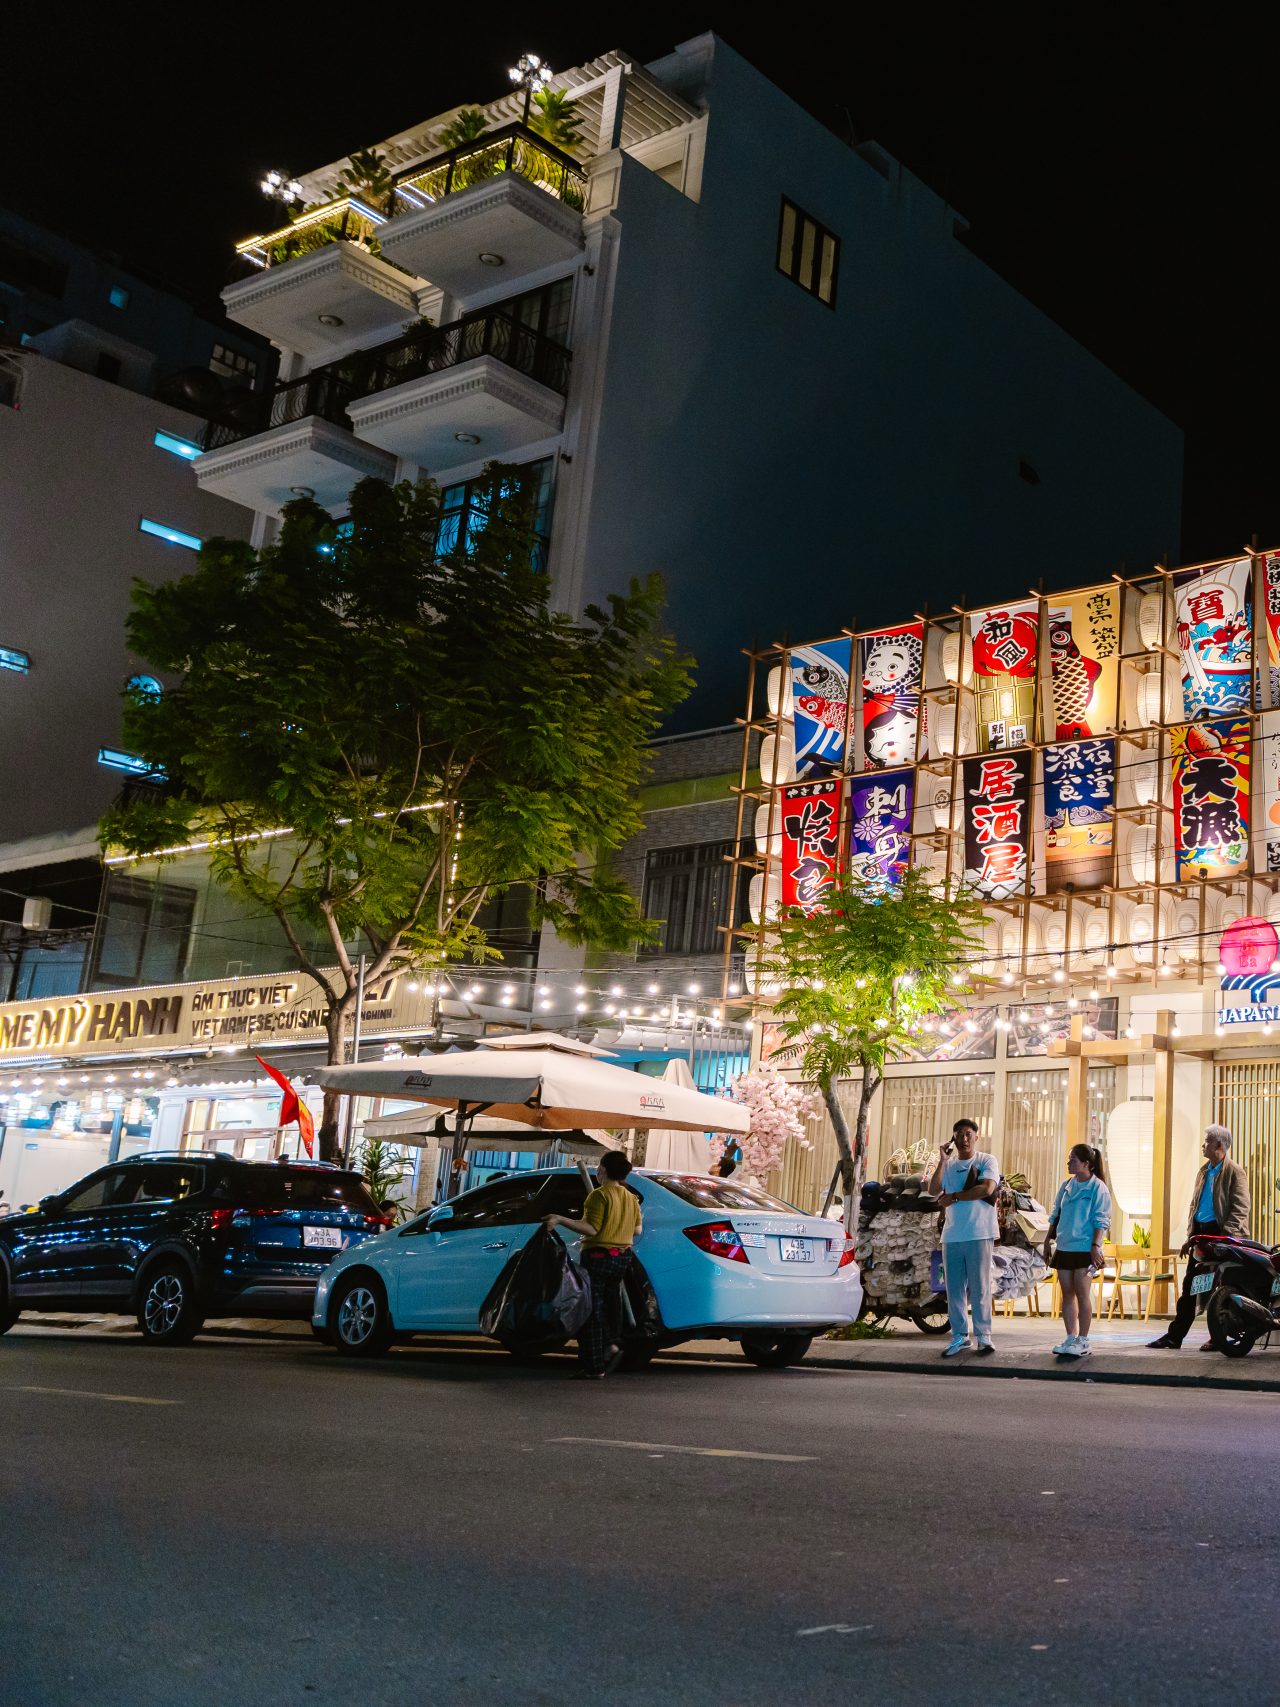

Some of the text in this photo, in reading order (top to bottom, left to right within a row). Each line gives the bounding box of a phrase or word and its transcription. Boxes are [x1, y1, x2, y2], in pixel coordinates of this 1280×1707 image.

[983, 619, 1028, 669] 和風
[860, 783, 907, 868] 刺身
[968, 758, 1027, 884] 居酒屋
[87, 995, 184, 1044] HẠNH
